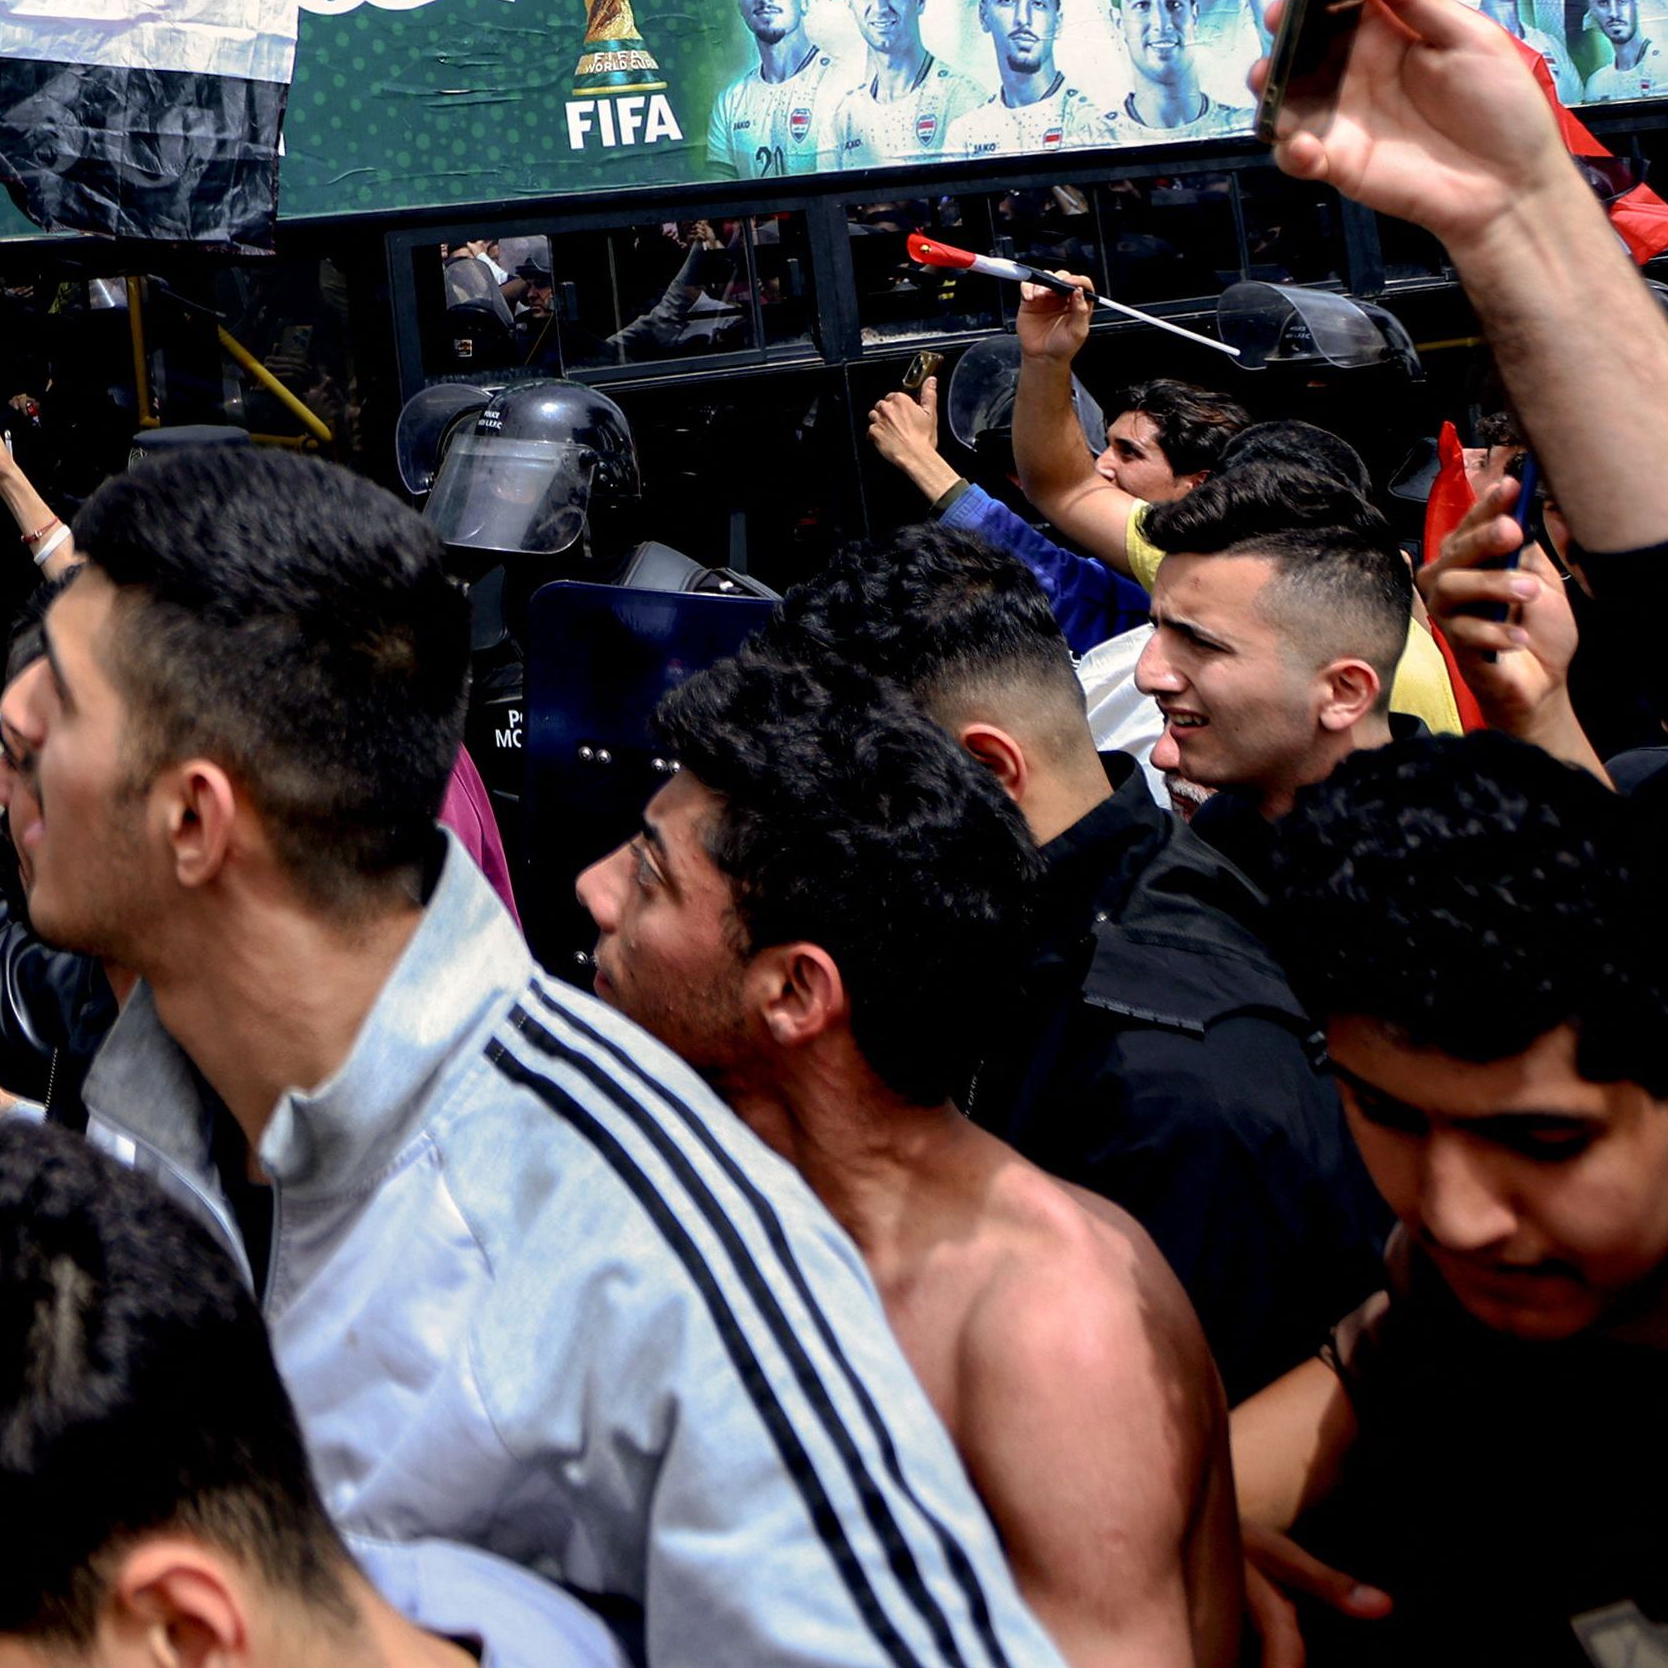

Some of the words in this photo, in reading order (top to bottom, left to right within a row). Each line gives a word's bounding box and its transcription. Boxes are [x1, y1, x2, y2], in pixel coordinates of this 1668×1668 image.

[593, 50, 642, 62] FIFA
[585, 61, 627, 73] WORLD
[564, 93, 684, 150] FIFA
[973, 142, 997, 155] JAKO
